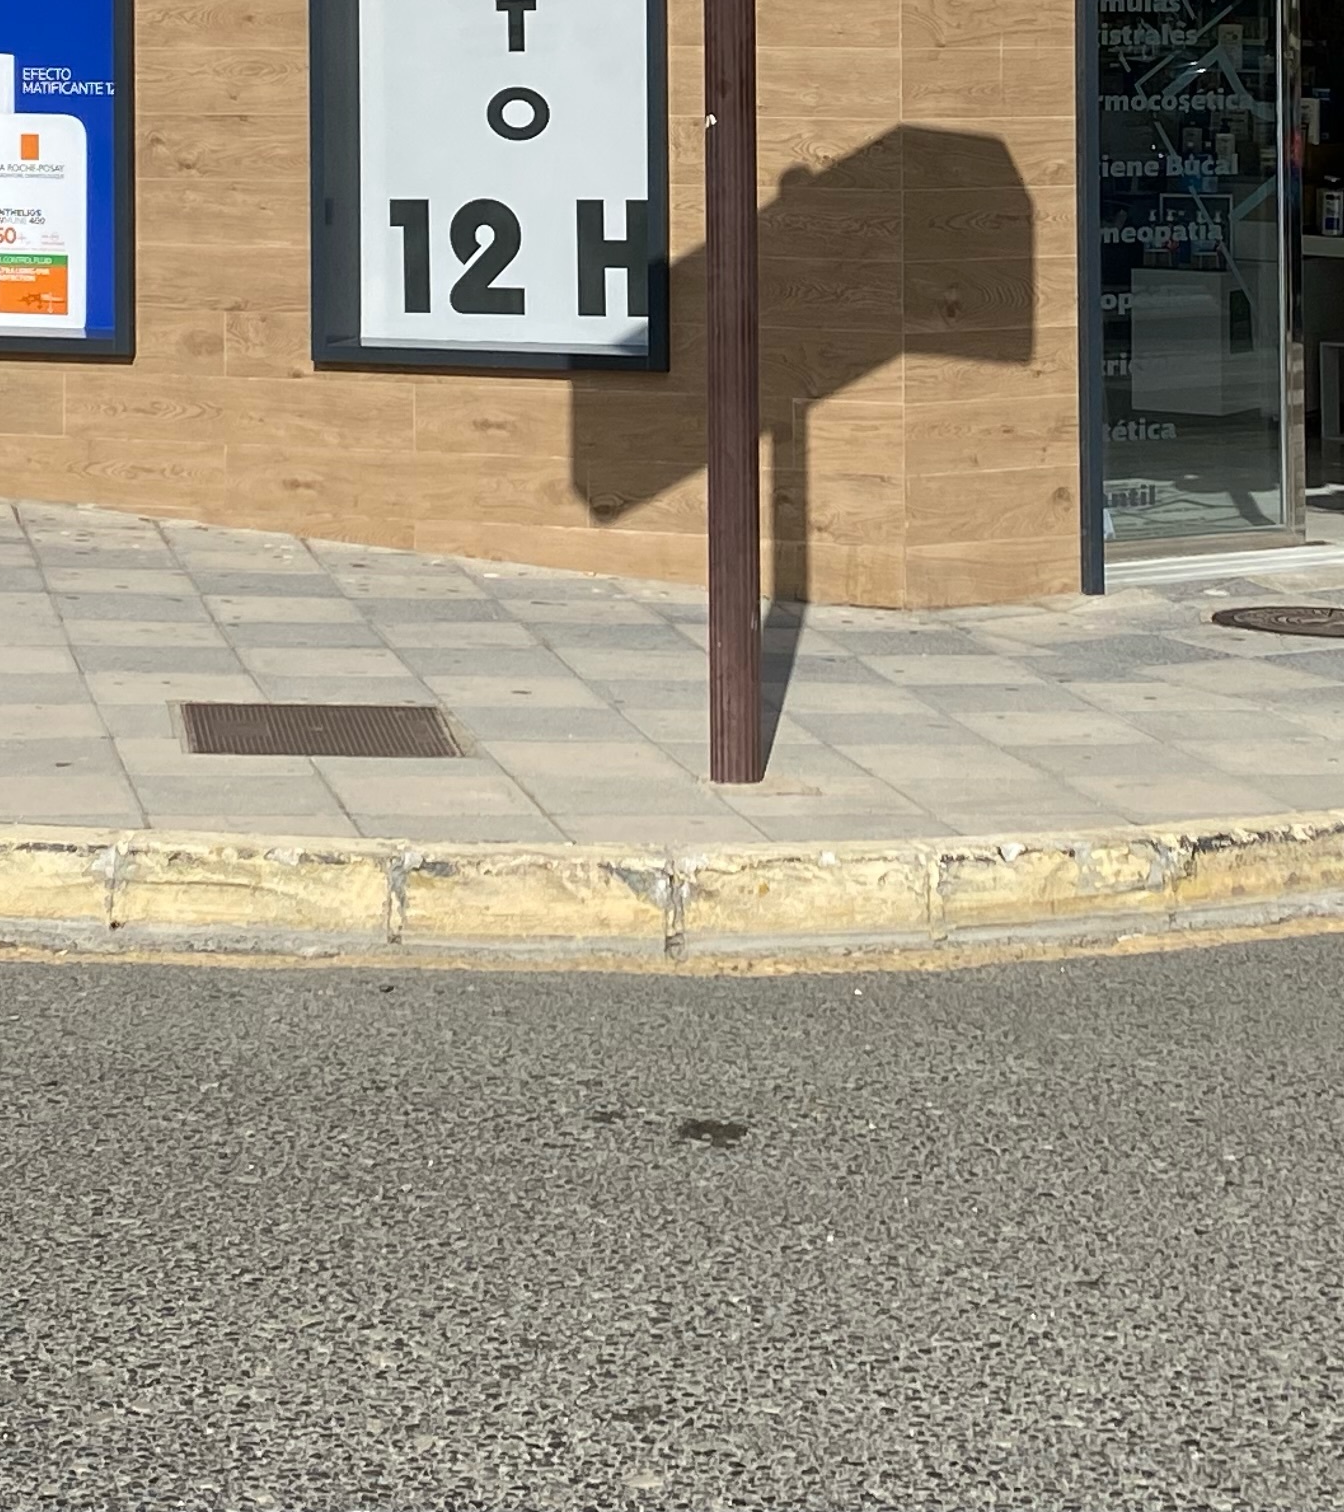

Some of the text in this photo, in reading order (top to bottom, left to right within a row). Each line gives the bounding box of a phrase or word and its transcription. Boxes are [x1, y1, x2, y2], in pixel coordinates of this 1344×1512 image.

[1098, 23, 1199, 46] istrales
[22, 67, 72, 81] EFECTO
[22, 81, 103, 95] MATIFICANTE
[1099, 153, 1239, 178] iene Bucal
[389, 197, 649, 317] 12 H
